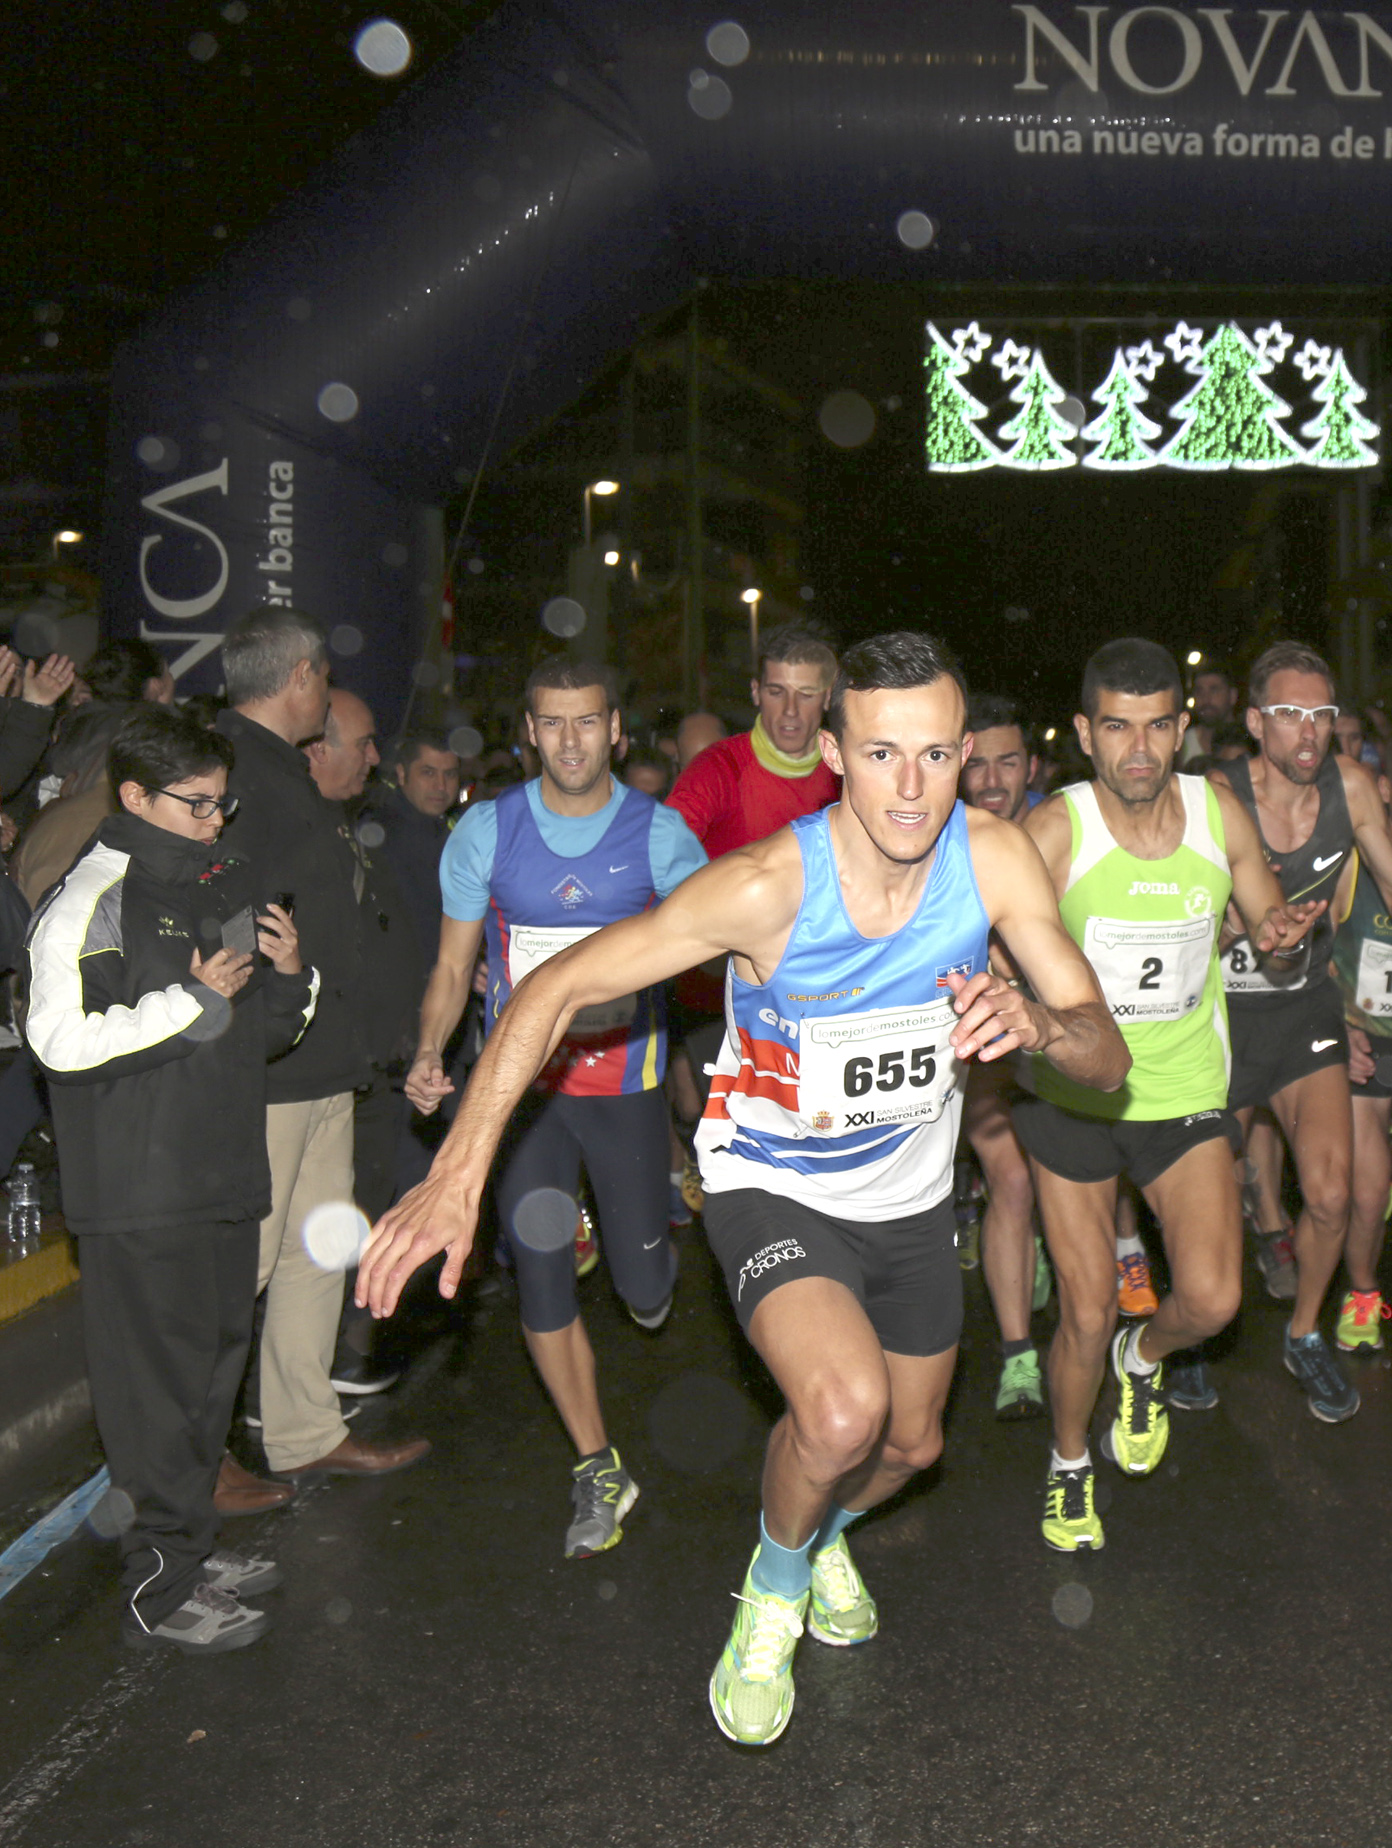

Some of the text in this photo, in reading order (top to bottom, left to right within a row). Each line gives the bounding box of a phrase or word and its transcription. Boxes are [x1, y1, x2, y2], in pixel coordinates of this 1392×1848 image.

[1013, 127, 1083, 155] una
[1092, 129, 1203, 157] nueva
[1213, 124, 1321, 159] forma
[1330, 127, 1375, 160] de
[259, 461, 293, 571] banca
[1138, 957, 1164, 990] 2
[1113, 1004, 1136, 1016] XXI
[843, 1045, 936, 1098] 655
[844, 1111, 875, 1128] XXI
[876, 1107, 933, 1124] MOSTOLEÑA
[750, 1246, 806, 1278] CRONOS
[754, 1238, 798, 1260] DEPORTES
